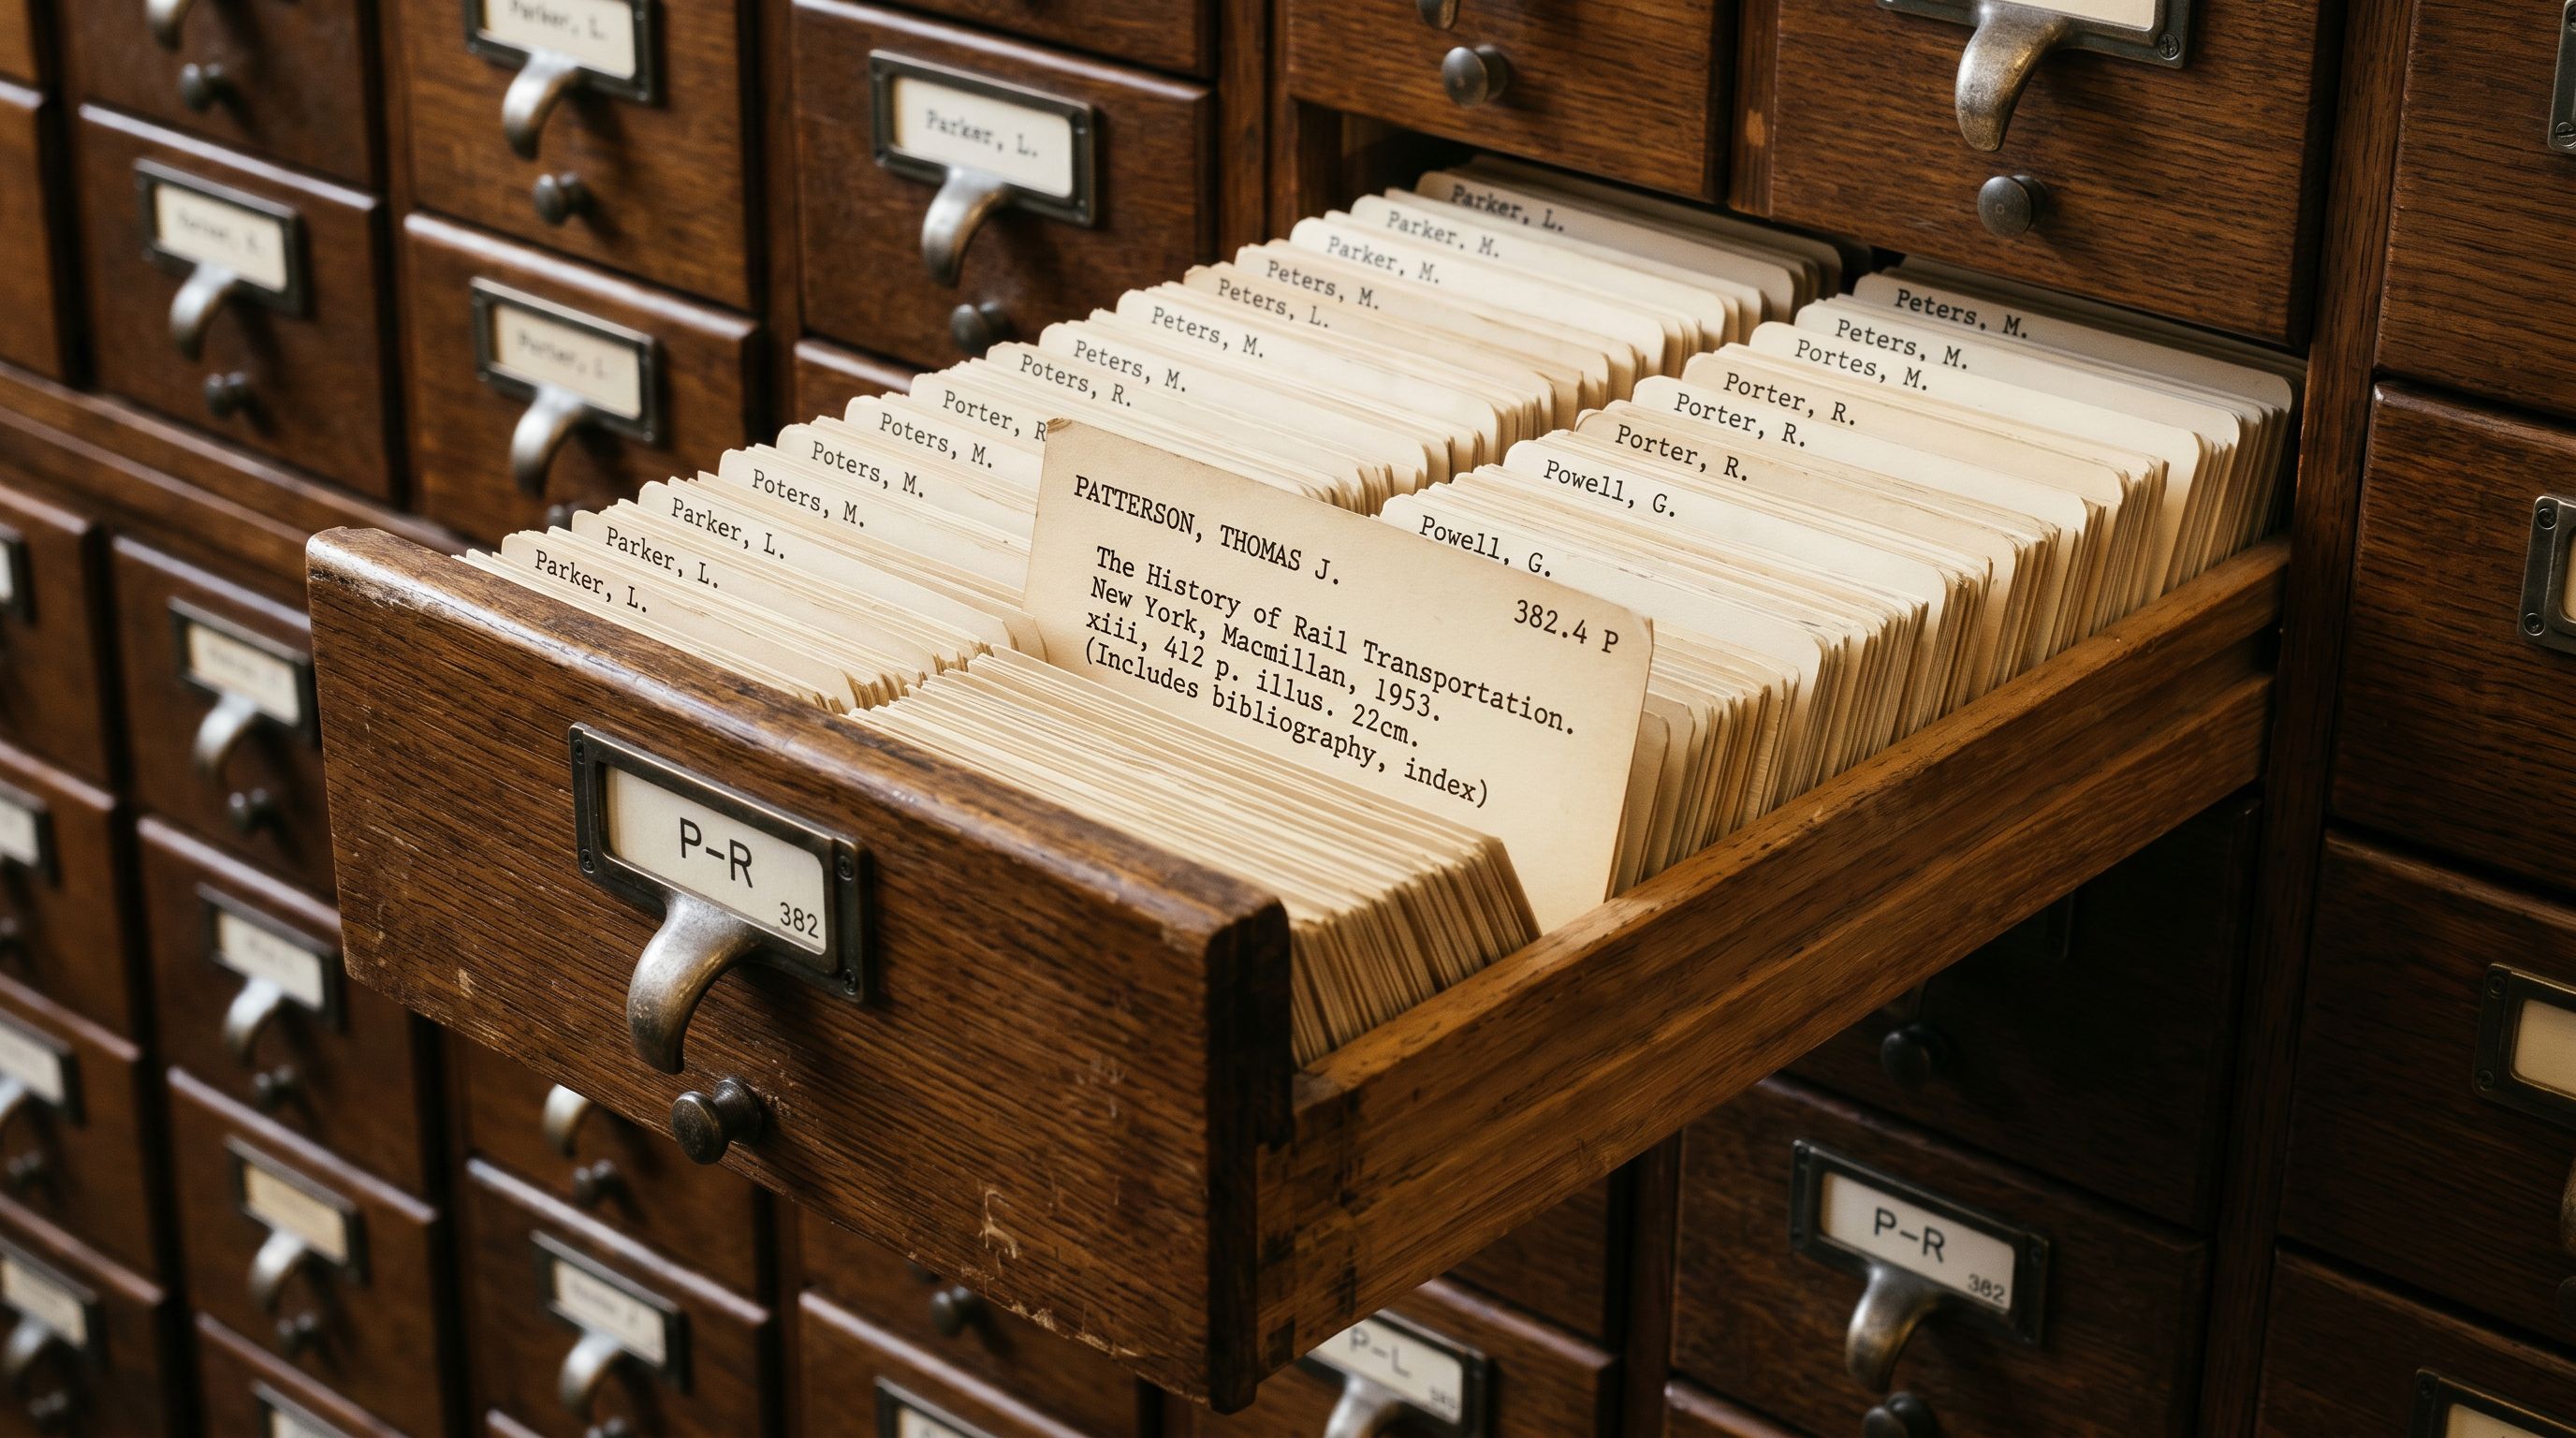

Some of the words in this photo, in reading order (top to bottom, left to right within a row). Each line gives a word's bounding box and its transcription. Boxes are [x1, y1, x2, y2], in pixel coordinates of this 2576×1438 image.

[926, 109, 1003, 152] Parker,
[1016, 133, 1038, 157] L.
[1452, 183, 1530, 225] Parker,
[1543, 209, 1564, 232] L.
[1326, 235, 1404, 276] Parker,
[1418, 261, 1440, 284] M.
[1478, 236, 1500, 257] M.
[1217, 278, 1294, 321] Peters,
[1309, 306, 1329, 329] L.
[1267, 260, 1344, 303] Peters,
[1358, 286, 1380, 310] M.
[1151, 306, 1228, 350] Peters,
[1242, 334, 1264, 358] M.
[1895, 288, 1986, 330] Peters,
[2002, 315, 2027, 339] M.
[1074, 340, 1150, 384] Peters,
[1164, 369, 1186, 392] M.
[1794, 339, 1885, 383] Portes,
[1902, 367, 1927, 390] M.
[1836, 318, 1926, 362] Peters,
[1942, 345, 1968, 370] M.
[1019, 354, 1097, 399] Poters,
[1111, 384, 1131, 406] R.
[1723, 372, 1814, 418] Porter,
[1831, 402, 1855, 426] R.
[879, 413, 957, 461] Poters,
[971, 443, 993, 468] M.
[943, 390, 1020, 437] Porter,
[1034, 421, 1047, 442] R
[1674, 392, 1764, 440] Porter,
[1781, 422, 1806, 448] R.
[811, 441, 888, 490] Poters,
[901, 472, 924, 498] M.
[1615, 424, 1706, 474] Porter,
[1723, 456, 1748, 481] R.
[752, 469, 829, 519] Poters,
[842, 501, 865, 528] M.
[1544, 460, 1634, 509] Powell,
[1652, 492, 1676, 517] G.
[672, 497, 750, 550] Parker,
[763, 533, 784, 560] L.
[1074, 475, 1202, 543] PATTERSON,
[1220, 524, 1301, 571] THOMAS
[1315, 558, 1339, 584] J.
[1419, 515, 1510, 566] Powell,
[1529, 551, 1551, 577] G.
[534, 550, 611, 603] Parker,
[626, 586, 647, 613] L.
[606, 526, 683, 577] Parker,
[697, 562, 718, 589] L.
[1090, 576, 1133, 608] New
[1145, 595, 1206, 640] York,
[1222, 624, 1355, 696] Macmillan,
[1375, 679, 1439, 722] 1953.
[1097, 546, 1134, 578] The
[1146, 563, 1241, 618] History
[1253, 607, 1282, 629] of
[1294, 615, 1348, 654] Rail
[1364, 639, 1573, 735] Transportation.
[1515, 600, 1588, 644] 382.4
[1602, 629, 1618, 653] P
[1086, 611, 1148, 653] xiii,
[1164, 636, 1204, 668] 412
[1215, 658, 1238, 682] p.
[1256, 669, 1333, 716] illus.
[1352, 704, 1418, 747] 22cm.
[1086, 637, 1199, 698] (Includes
[1213, 684, 1385, 773] bibliography,
[1404, 757, 1487, 808] index)
[780, 902, 819, 939] 382
[1968, 1274, 2006, 1303] 382
